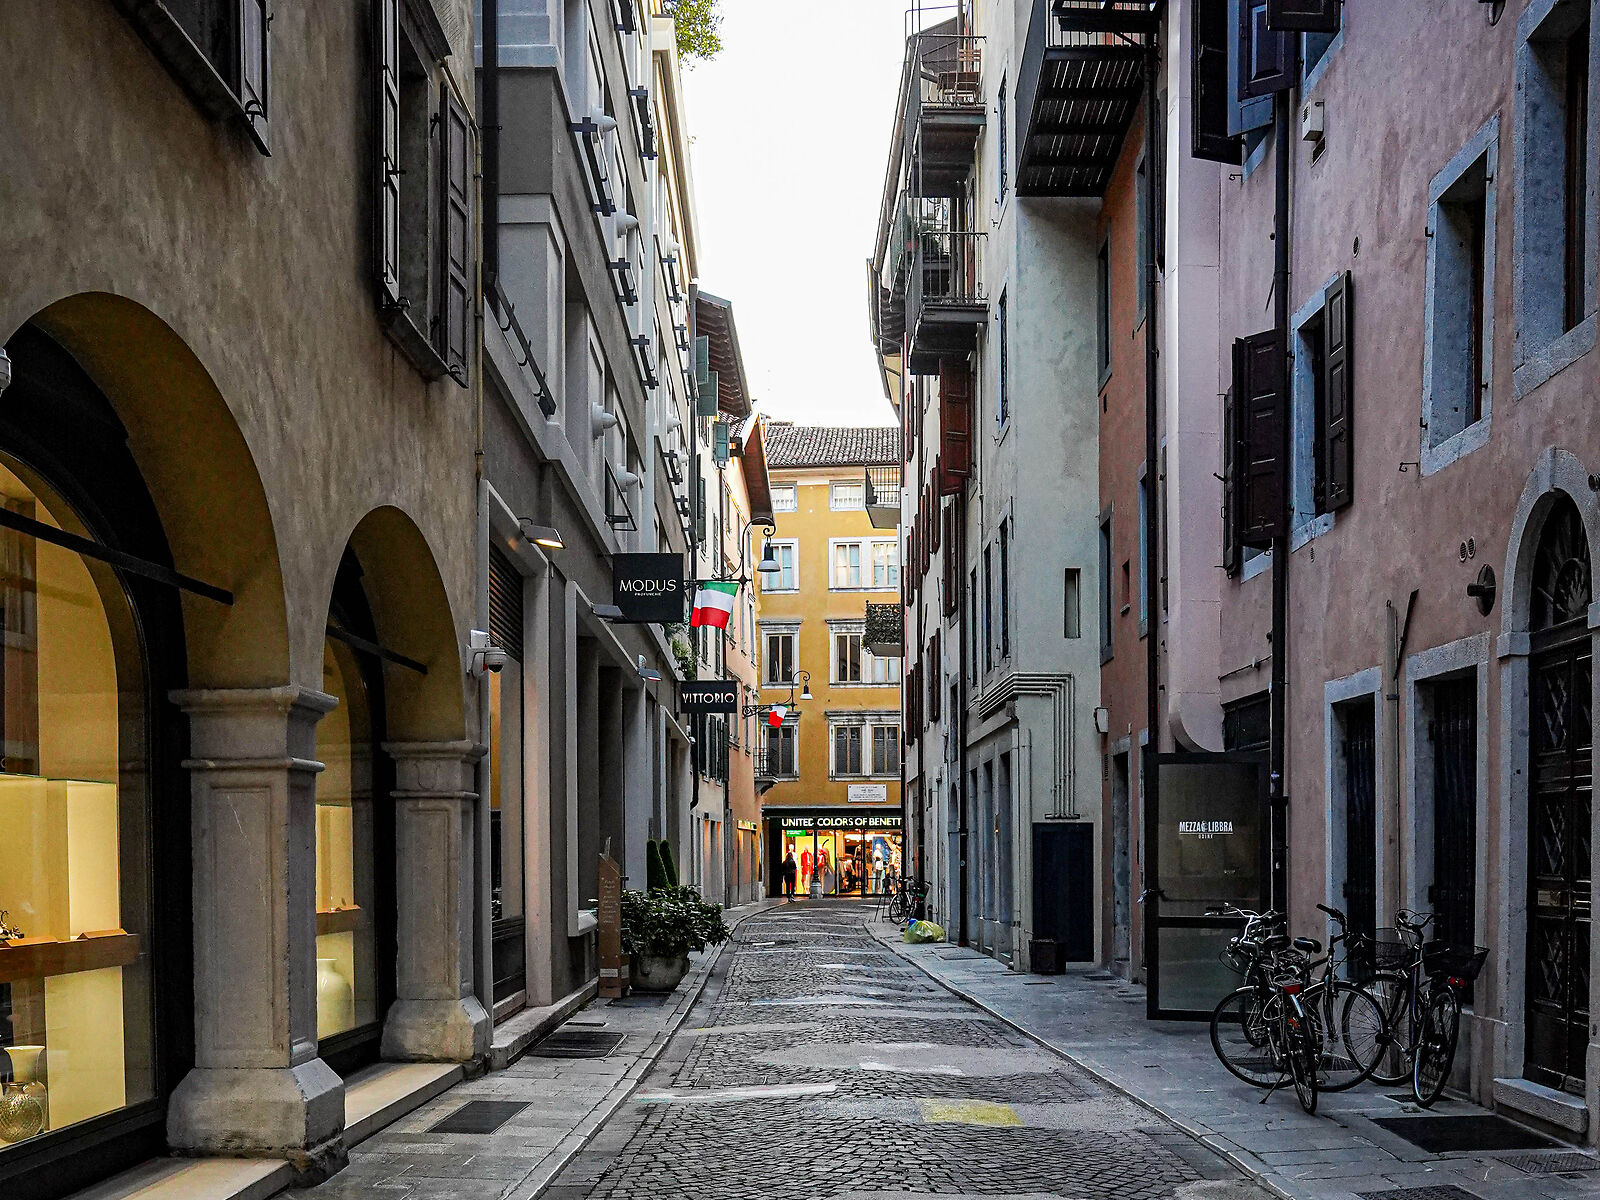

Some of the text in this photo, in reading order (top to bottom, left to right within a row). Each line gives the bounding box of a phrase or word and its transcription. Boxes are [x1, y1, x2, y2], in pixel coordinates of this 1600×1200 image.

[619, 579, 677, 592] MODUS
[682, 692, 735, 704] VITTORIO
[816, 817, 854, 827] COLORS
[854, 817, 868, 827] OF
[1179, 821, 1233, 832] MEZZA LIBBRA
